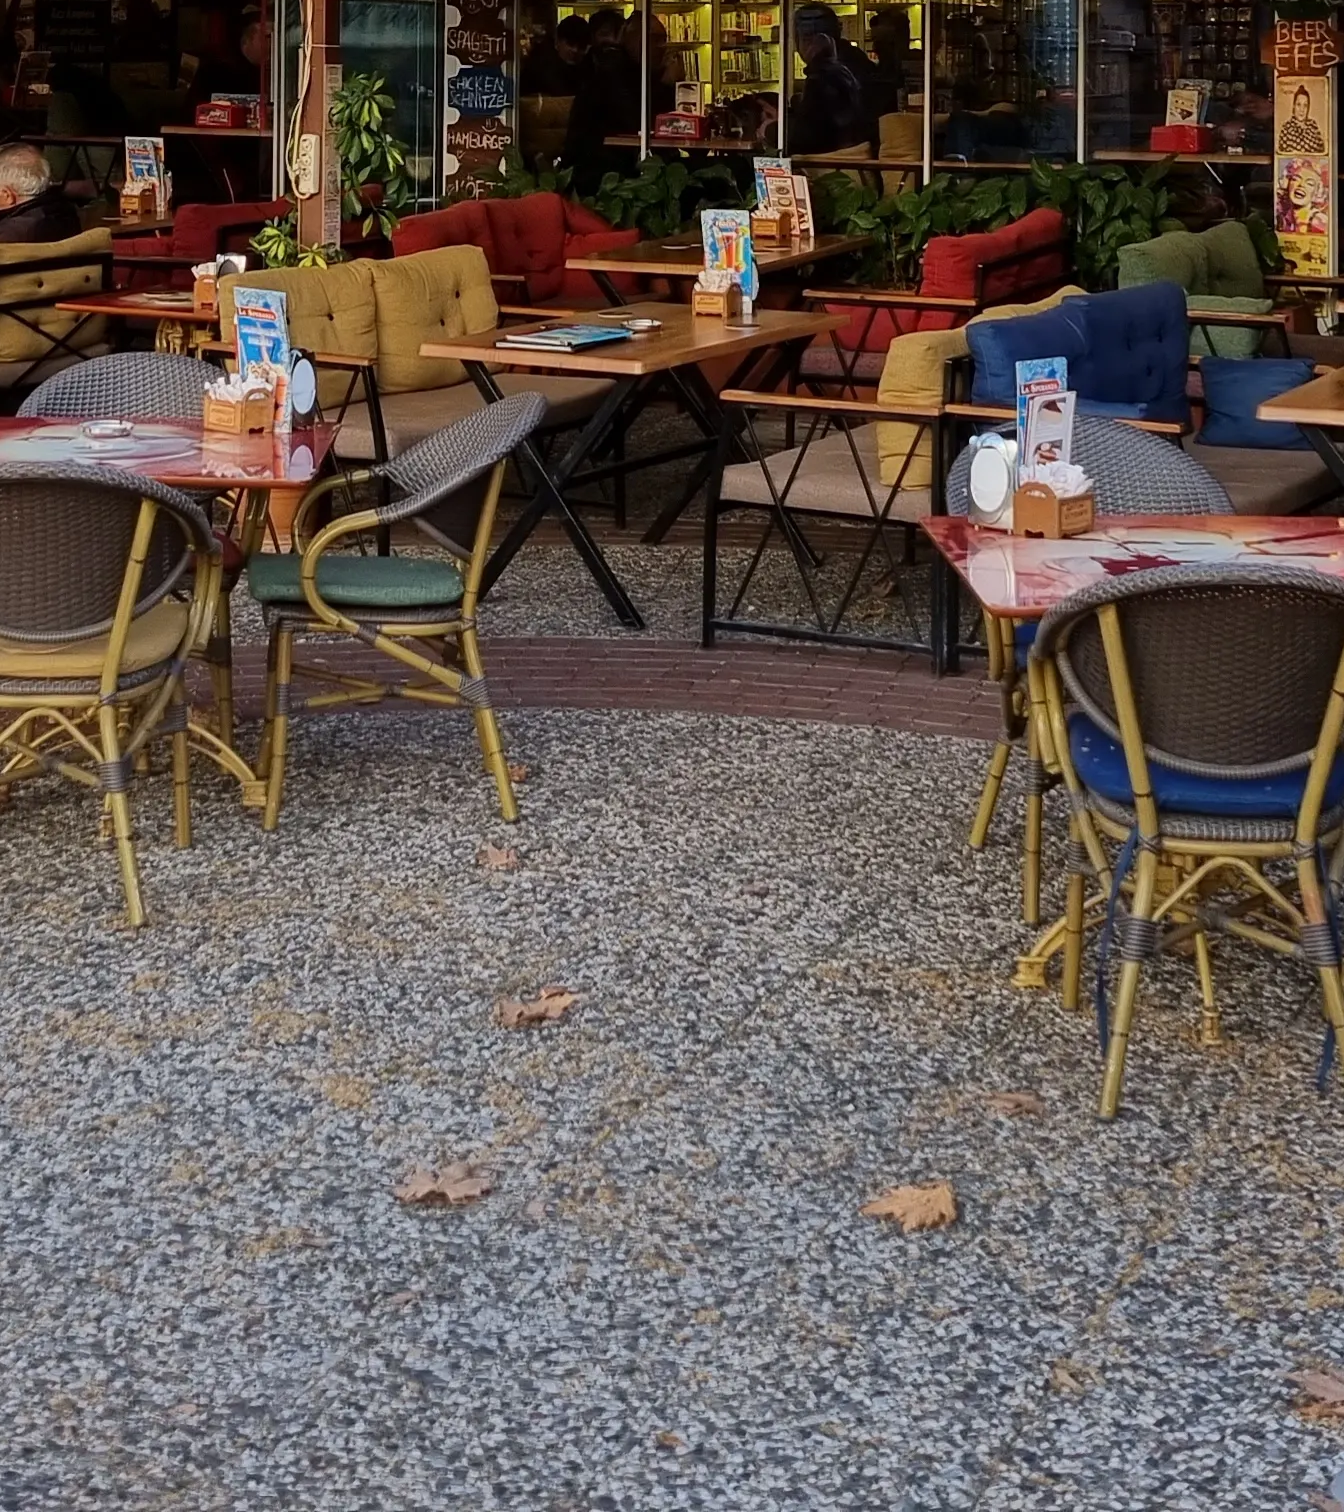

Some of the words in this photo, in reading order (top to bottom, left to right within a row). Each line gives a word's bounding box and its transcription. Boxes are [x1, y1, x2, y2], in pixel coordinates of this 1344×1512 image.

[1275, 20, 1331, 43] BEER
[1275, 41, 1340, 70] EFES
[448, 75, 504, 91] CHICKEN
[448, 90, 513, 109] SCHNITZEL
